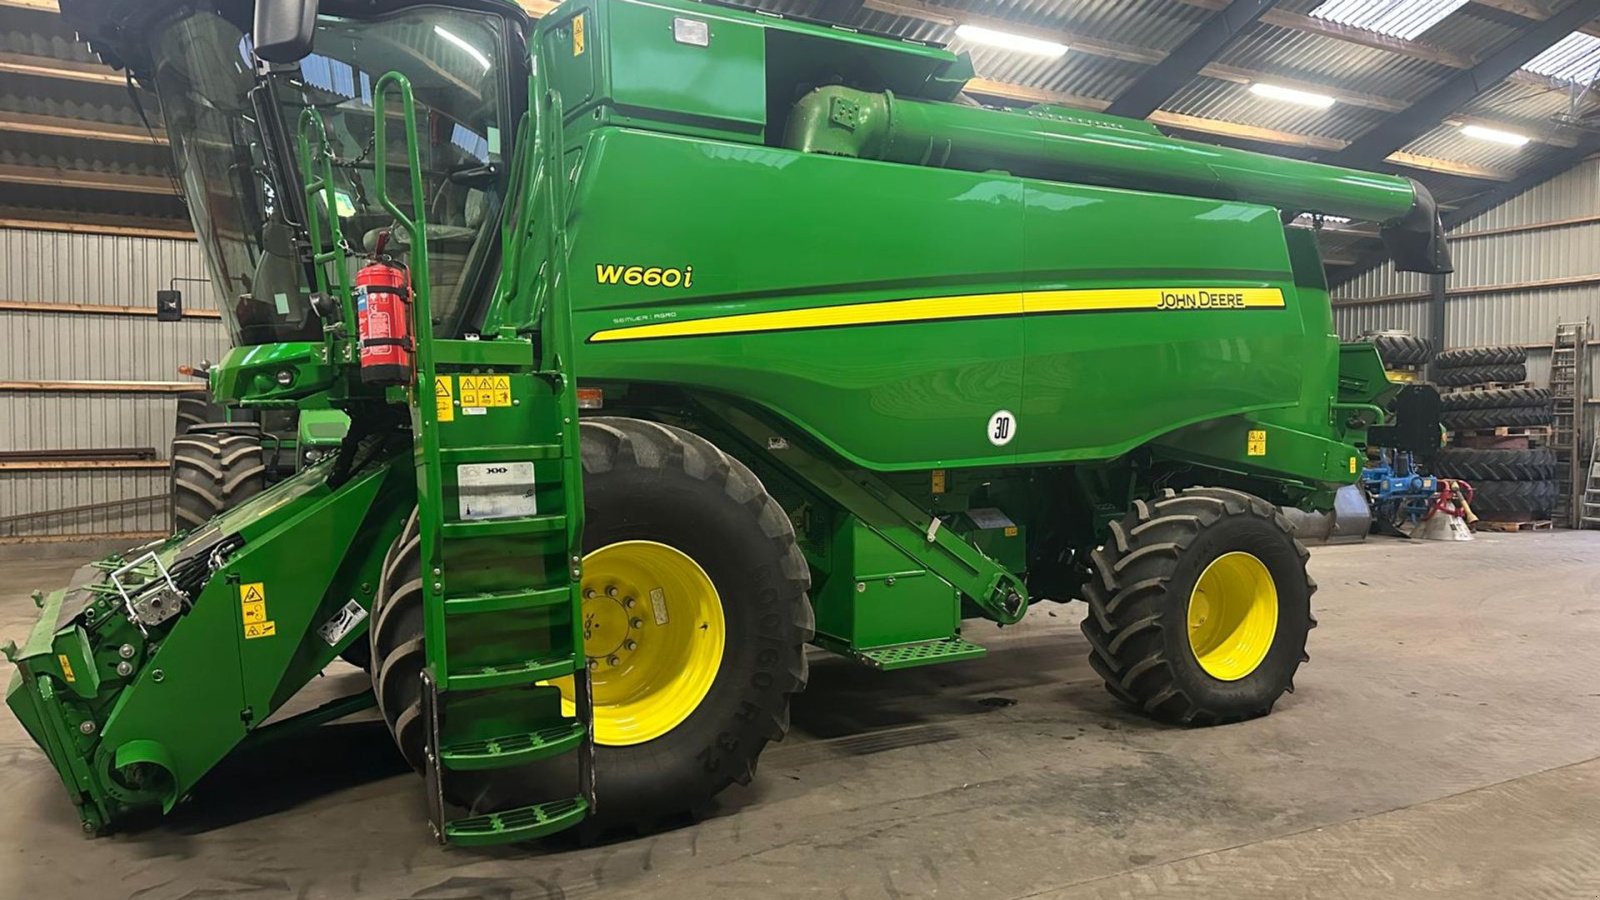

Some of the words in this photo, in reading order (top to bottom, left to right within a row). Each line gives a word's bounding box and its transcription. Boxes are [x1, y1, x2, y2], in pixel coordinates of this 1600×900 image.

[595, 263, 693, 289] W660i
[1157, 290, 1196, 308] JOHN
[1198, 290, 1245, 308] DEERE
[994, 416, 1010, 440] 30
